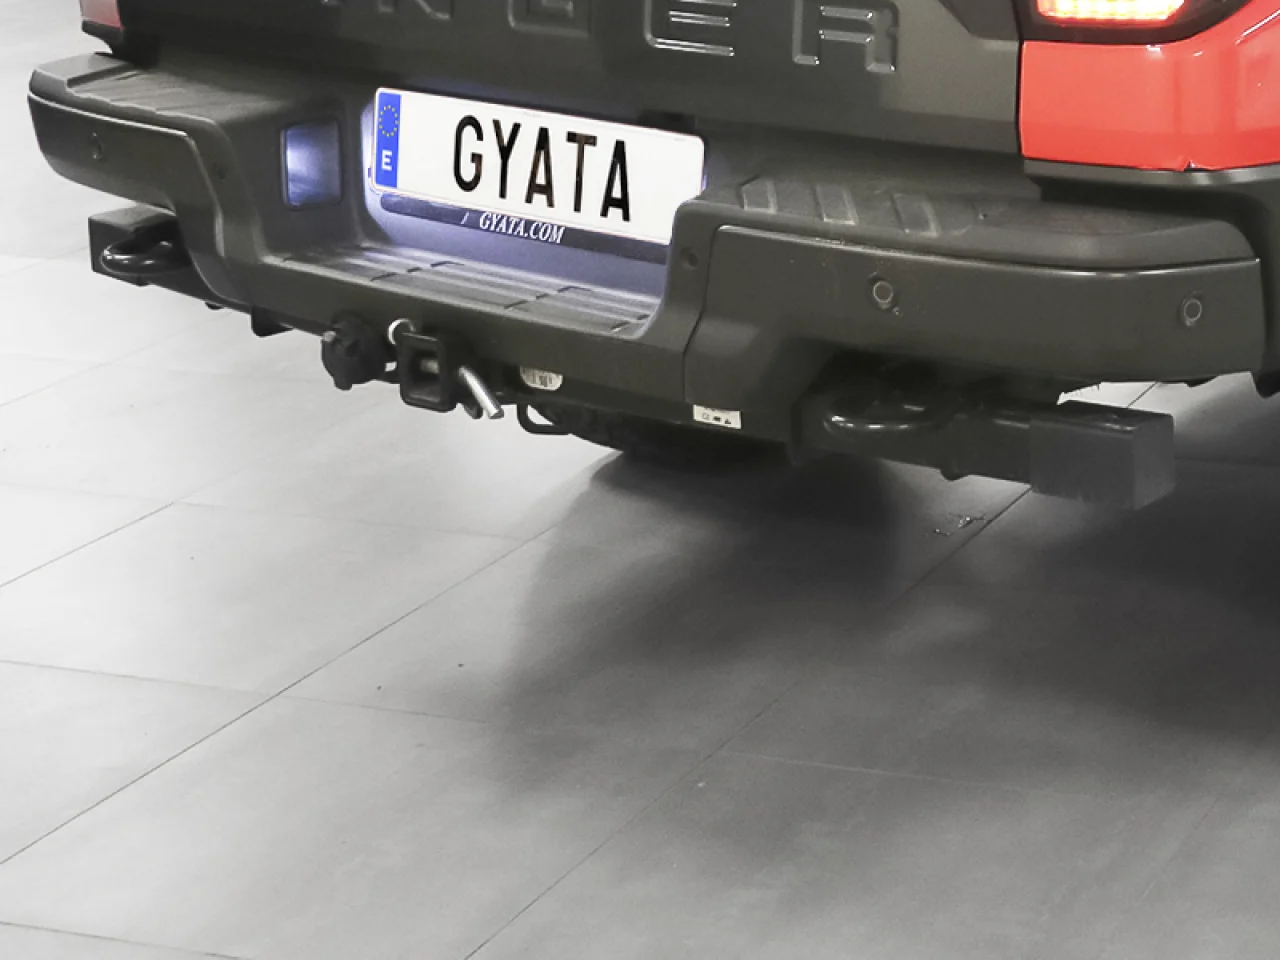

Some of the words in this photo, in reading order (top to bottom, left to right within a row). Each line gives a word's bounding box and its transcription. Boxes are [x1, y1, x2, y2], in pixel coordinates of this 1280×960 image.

[380, 149, 393, 171] E
[453, 114, 631, 222] GYATA
[479, 211, 566, 244] GYATA.COM
